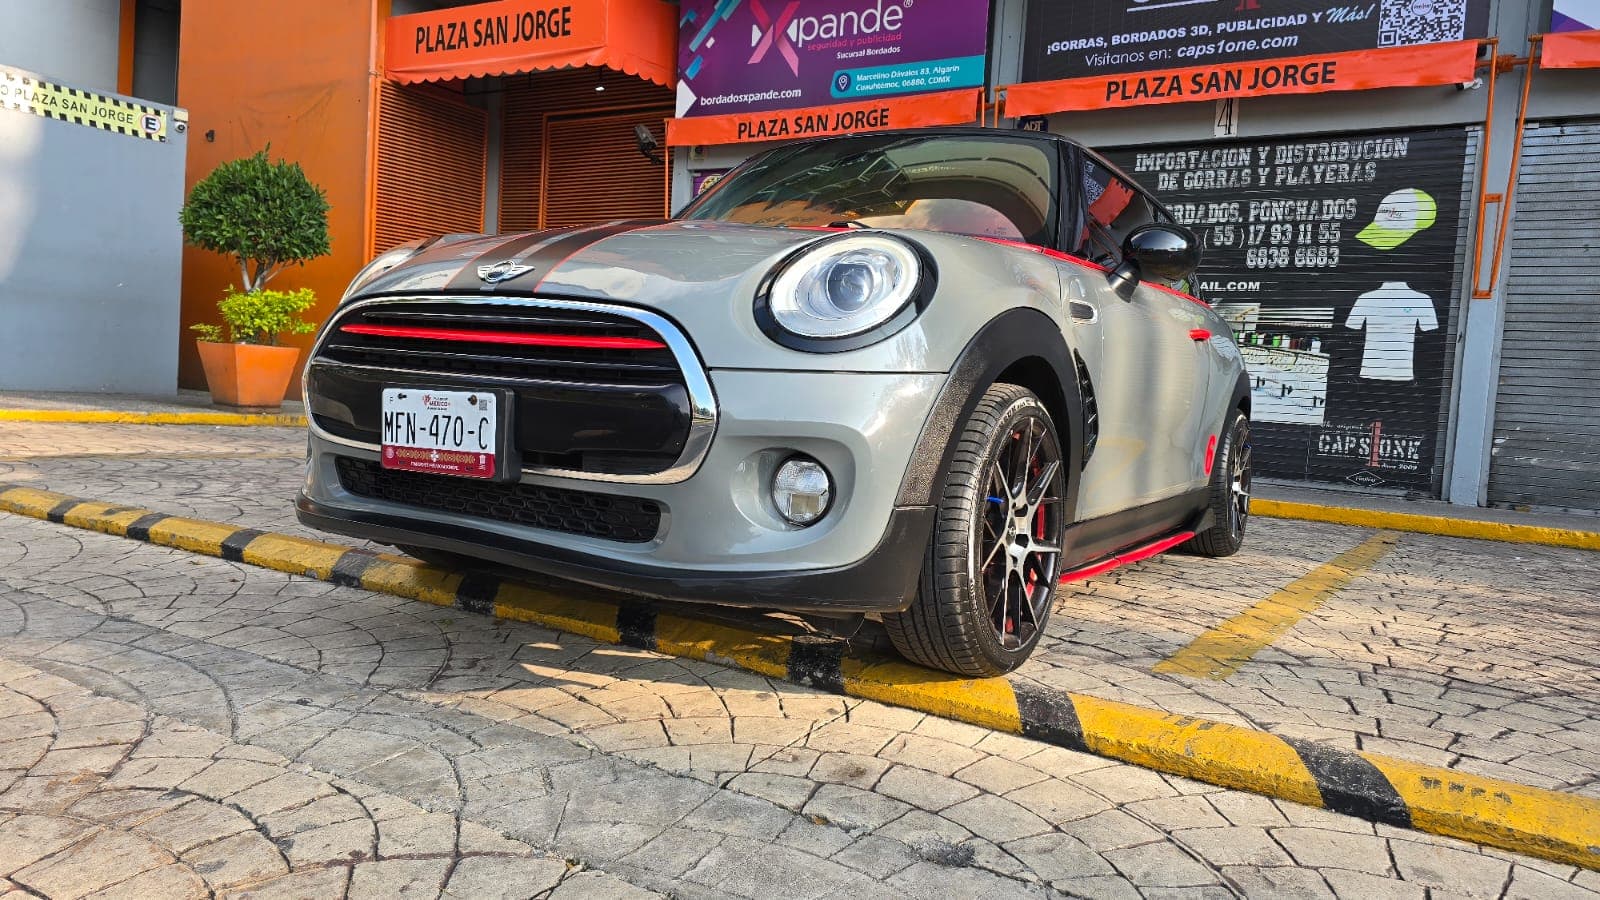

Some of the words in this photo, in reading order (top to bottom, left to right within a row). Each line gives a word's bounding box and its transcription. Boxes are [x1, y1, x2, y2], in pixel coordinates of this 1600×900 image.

[415, 21, 469, 54] PLAZA
[473, 15, 508, 48] SAN
[512, 6, 572, 42] JORGE
[807, 38, 848, 51] seguridad
[856, 32, 902, 48] publicidad
[1047, 36, 1108, 55] ¡GORRAS,
[1111, 27, 1187, 46] BORDADOS
[1190, 25, 1213, 37] 3D,
[1216, 13, 1307, 34] PUBLICIDAD
[1311, 11, 1323, 24] Y
[1326, 3, 1375, 24] Más!
[836, 49, 866, 60] Sucursal
[866, 46, 901, 57] Bordados
[1148, 48, 1173, 61] en:
[1177, 34, 1299, 59] caps1one.com
[856, 72, 890, 82] Marcelino
[928, 76, 951, 86] CDMX
[1105, 75, 1183, 102] PLAZA
[1190, 69, 1243, 95] SAN
[1247, 60, 1338, 90] JORGE
[14, 87, 58, 107] PLAZA
[62, 98, 88, 114] SAN
[91, 106, 134, 124] JORGE
[700, 87, 802, 106] bordadosxpande.com
[145, 116, 157, 131] E
[737, 117, 790, 139] PLAZA
[793, 114, 829, 134] SAN
[831, 108, 890, 130] JORGE
[1023, 120, 1043, 131] ADT
[1134, 147, 1252, 173] IMPORTACION
[1256, 146, 1271, 166] Y
[1274, 137, 1410, 166] DISTRIBUCION
[1158, 172, 1179, 191] DE
[1183, 169, 1251, 189] GORRAS
[1257, 166, 1271, 186] Y
[1274, 161, 1378, 186] PLAYERAS
[1249, 198, 1358, 223] PONCHADOS
[1247, 224, 1266, 246] 17
[1270, 223, 1293, 245] 93
[1318, 222, 1341, 244] 55
[1200, 281, 1261, 292] AIL.COM
[384, 411, 490, 450] MFN-470-C
